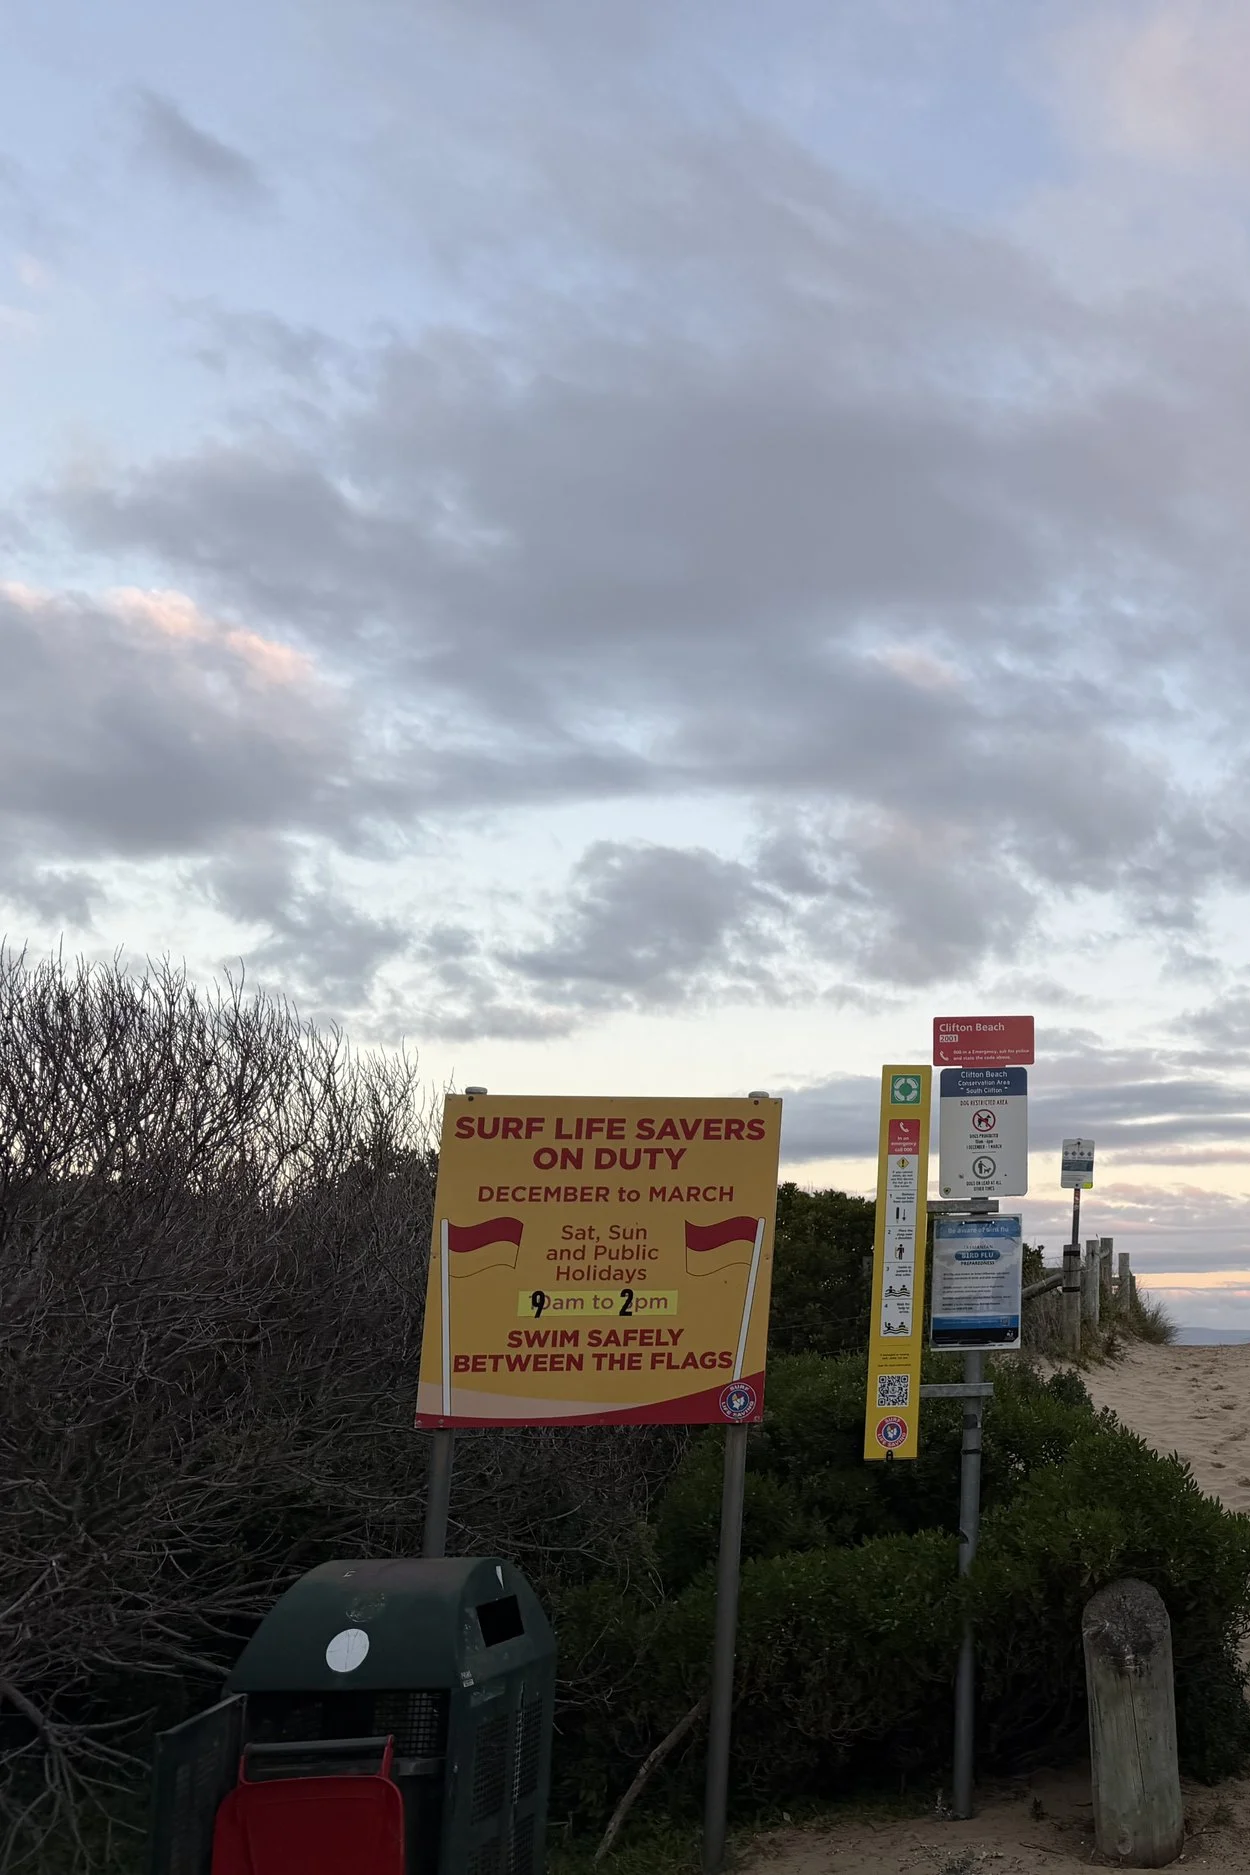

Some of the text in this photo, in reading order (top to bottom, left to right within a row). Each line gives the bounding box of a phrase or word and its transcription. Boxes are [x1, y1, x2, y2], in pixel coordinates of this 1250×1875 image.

[940, 1022, 1005, 1032] Clifton Beach
[986, 1070, 1008, 1078] Beach
[454, 1116, 766, 1141] SURF LIFE SAVERS
[533, 1147, 688, 1170] ON DUTY
[477, 1186, 734, 1202] DECEMBER to MARCH
[561, 1224, 648, 1244] Sat, Sun
[546, 1244, 659, 1260] and Public
[555, 1265, 648, 1283] Holidays
[592, 1294, 614, 1310] to
[506, 1328, 684, 1348] SWIM SAFELY
[453, 1350, 733, 1373] BETWEEN THE FLAGS
[721, 1400, 754, 1417] LIFE SAVING
